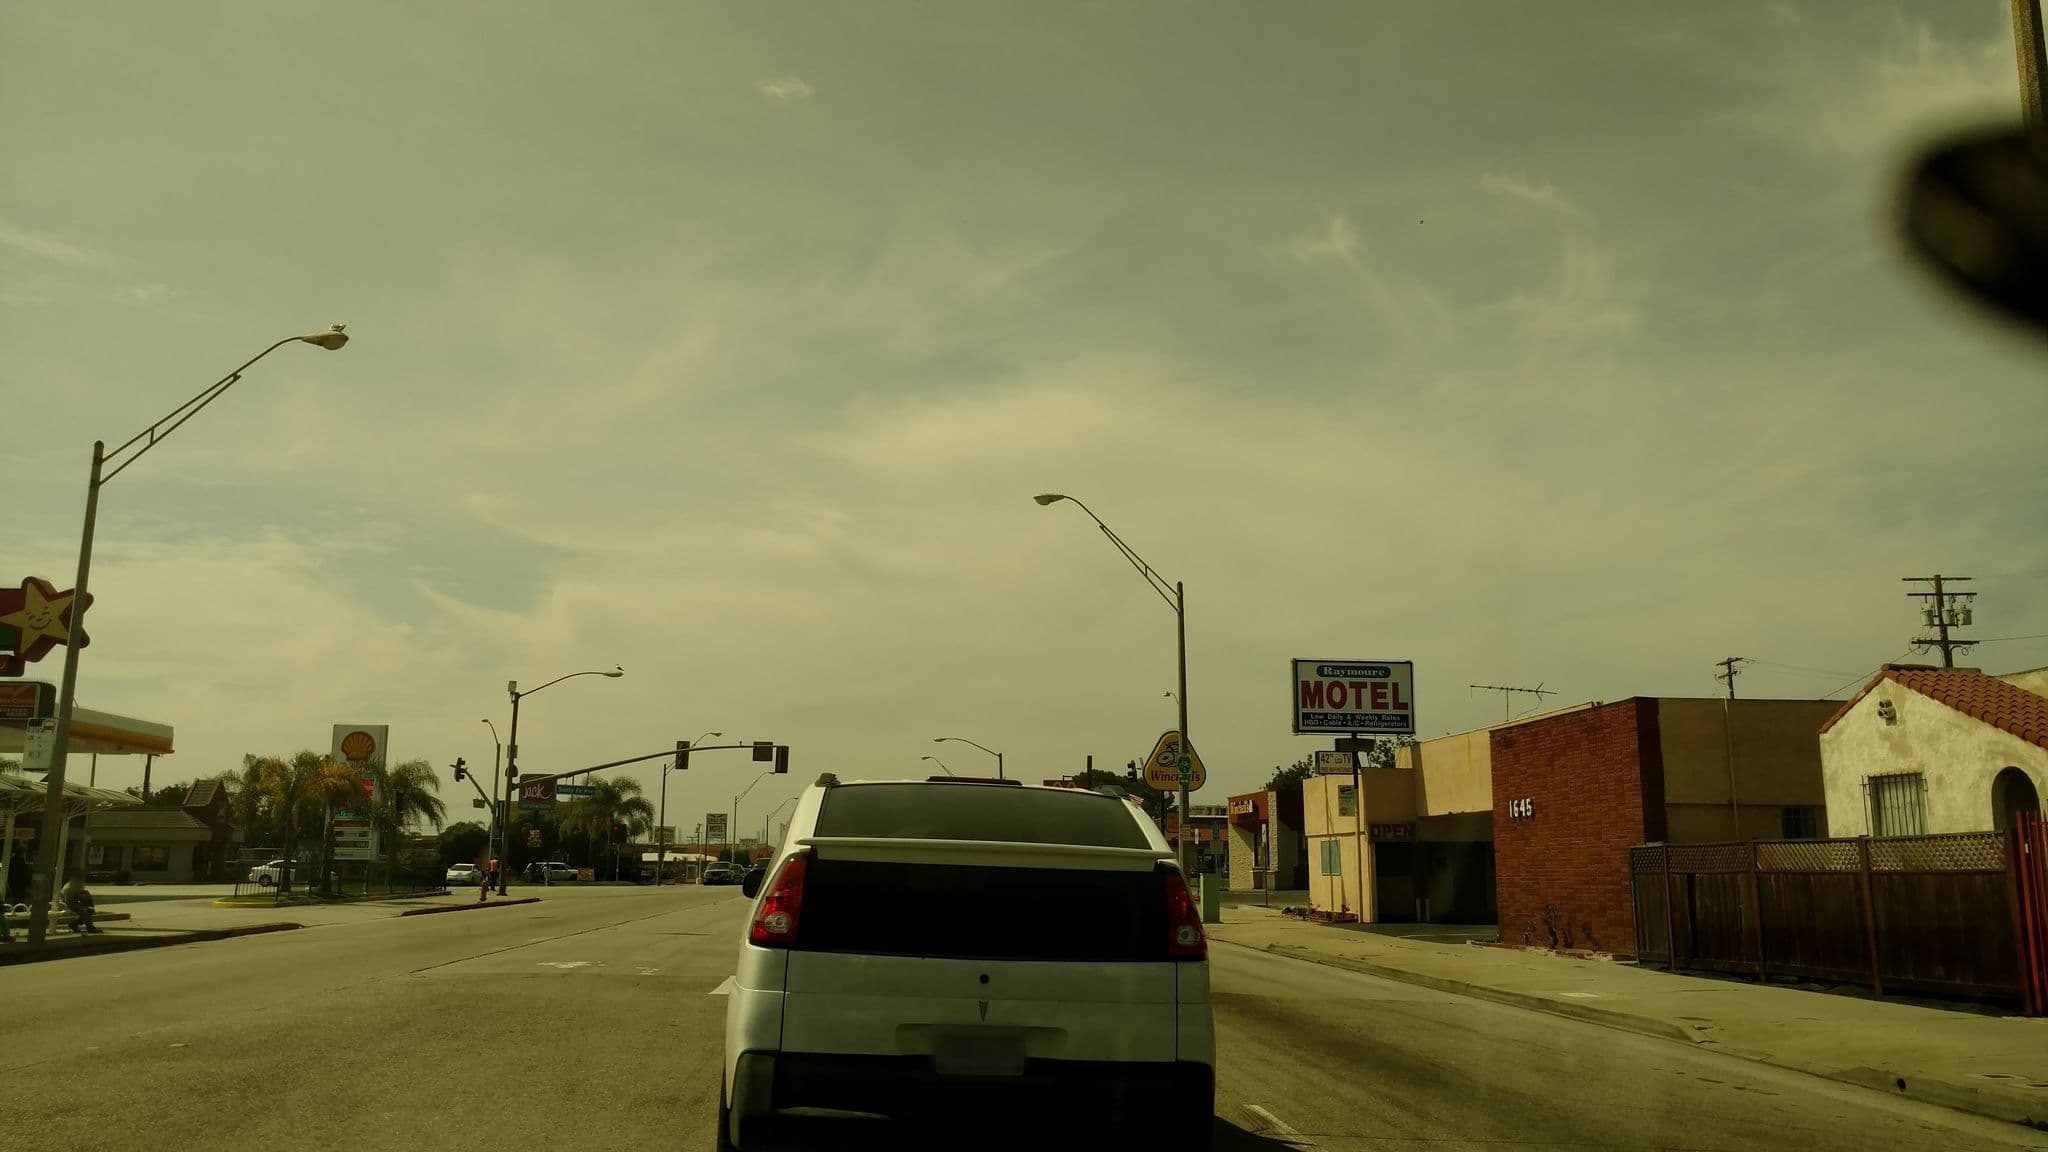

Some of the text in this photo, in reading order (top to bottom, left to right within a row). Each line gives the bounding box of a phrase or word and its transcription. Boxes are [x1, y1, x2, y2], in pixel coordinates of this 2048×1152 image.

[1323, 666, 1385, 677] Raymoure
[1301, 680, 1408, 710] MOTEL
[1343, 753, 1351, 764] TV
[1151, 770, 1200, 782] Wincl's
[1509, 798, 1532, 818] 1645
[1371, 824, 1413, 840] OPEN
